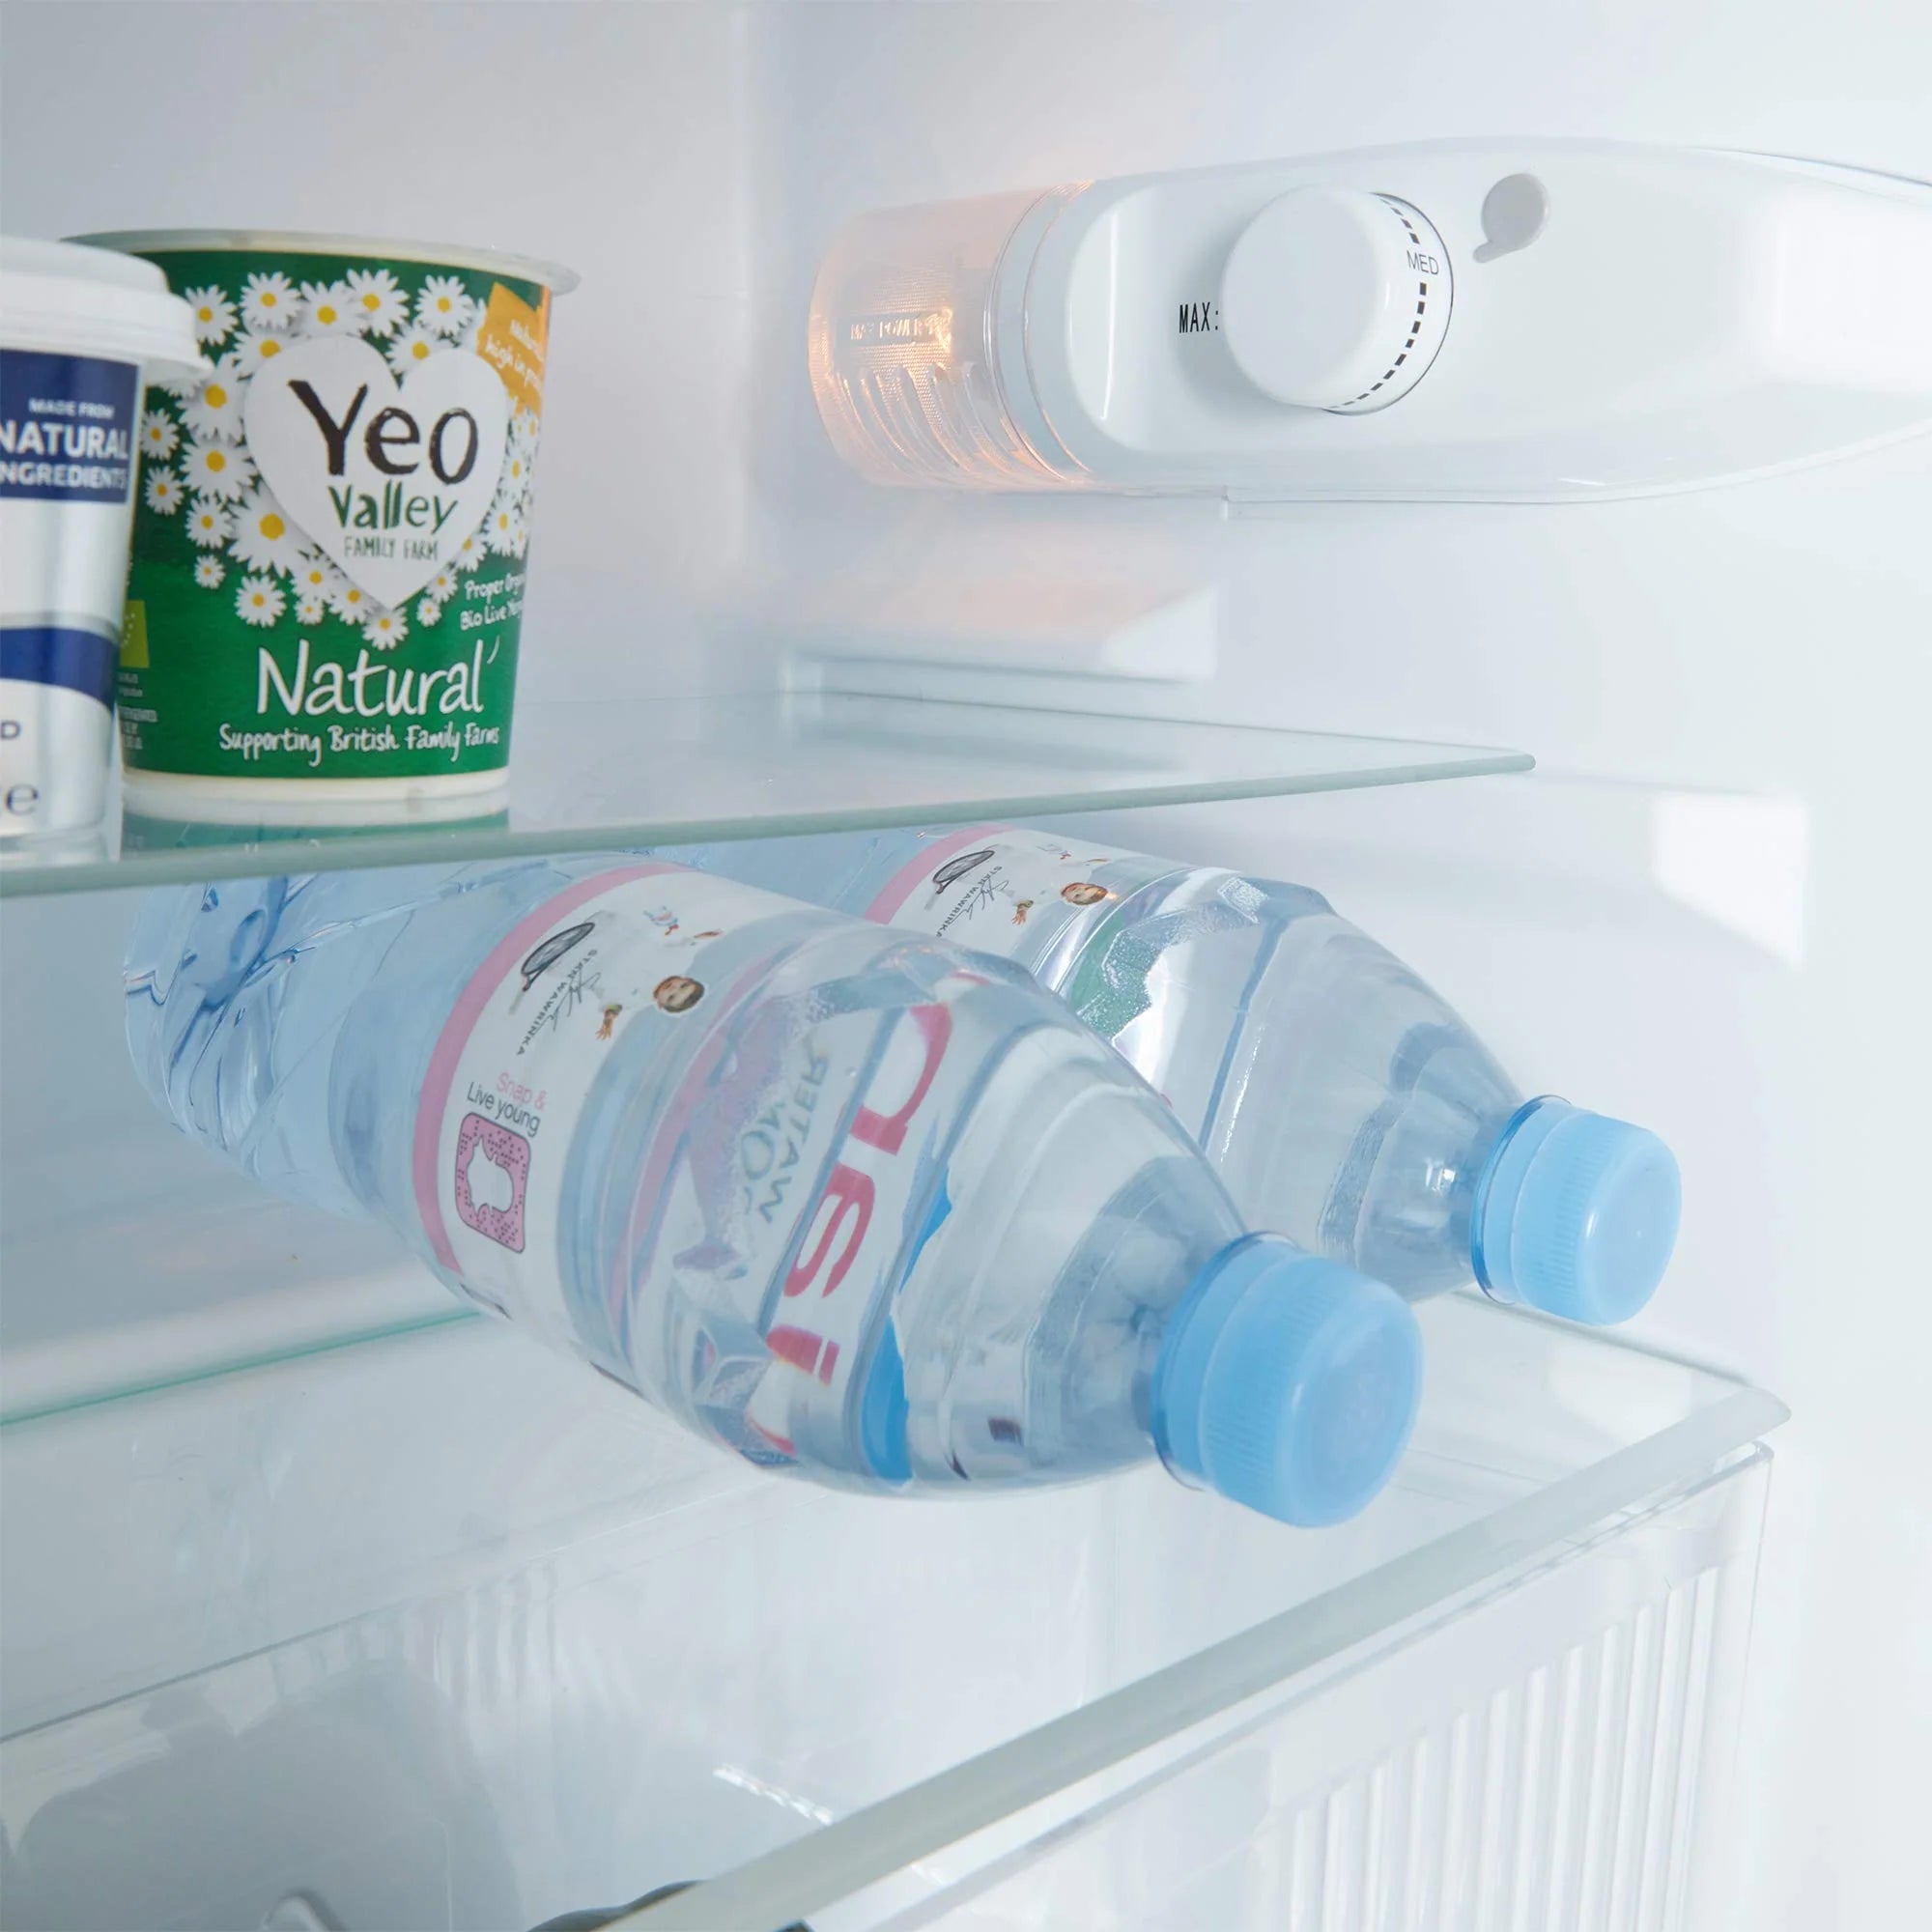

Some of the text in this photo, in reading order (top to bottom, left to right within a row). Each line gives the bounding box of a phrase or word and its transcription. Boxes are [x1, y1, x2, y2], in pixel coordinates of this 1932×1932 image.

[1406, 249, 1439, 275] MED
[0, 419, 128, 460] NATURAL
[288, 379, 478, 486] Yeo
[327, 479, 458, 535] Valley
[344, 536, 439, 561] FAMILY FARM
[465, 579, 504, 605] Proper
[460, 610, 483, 631] Bio
[484, 605, 507, 625] Live
[257, 639, 484, 717] Natural
[219, 722, 499, 767] Supporting British Family Farms
[467, 1081, 541, 1138] Live young
[496, 1071, 549, 1112] Snap &
